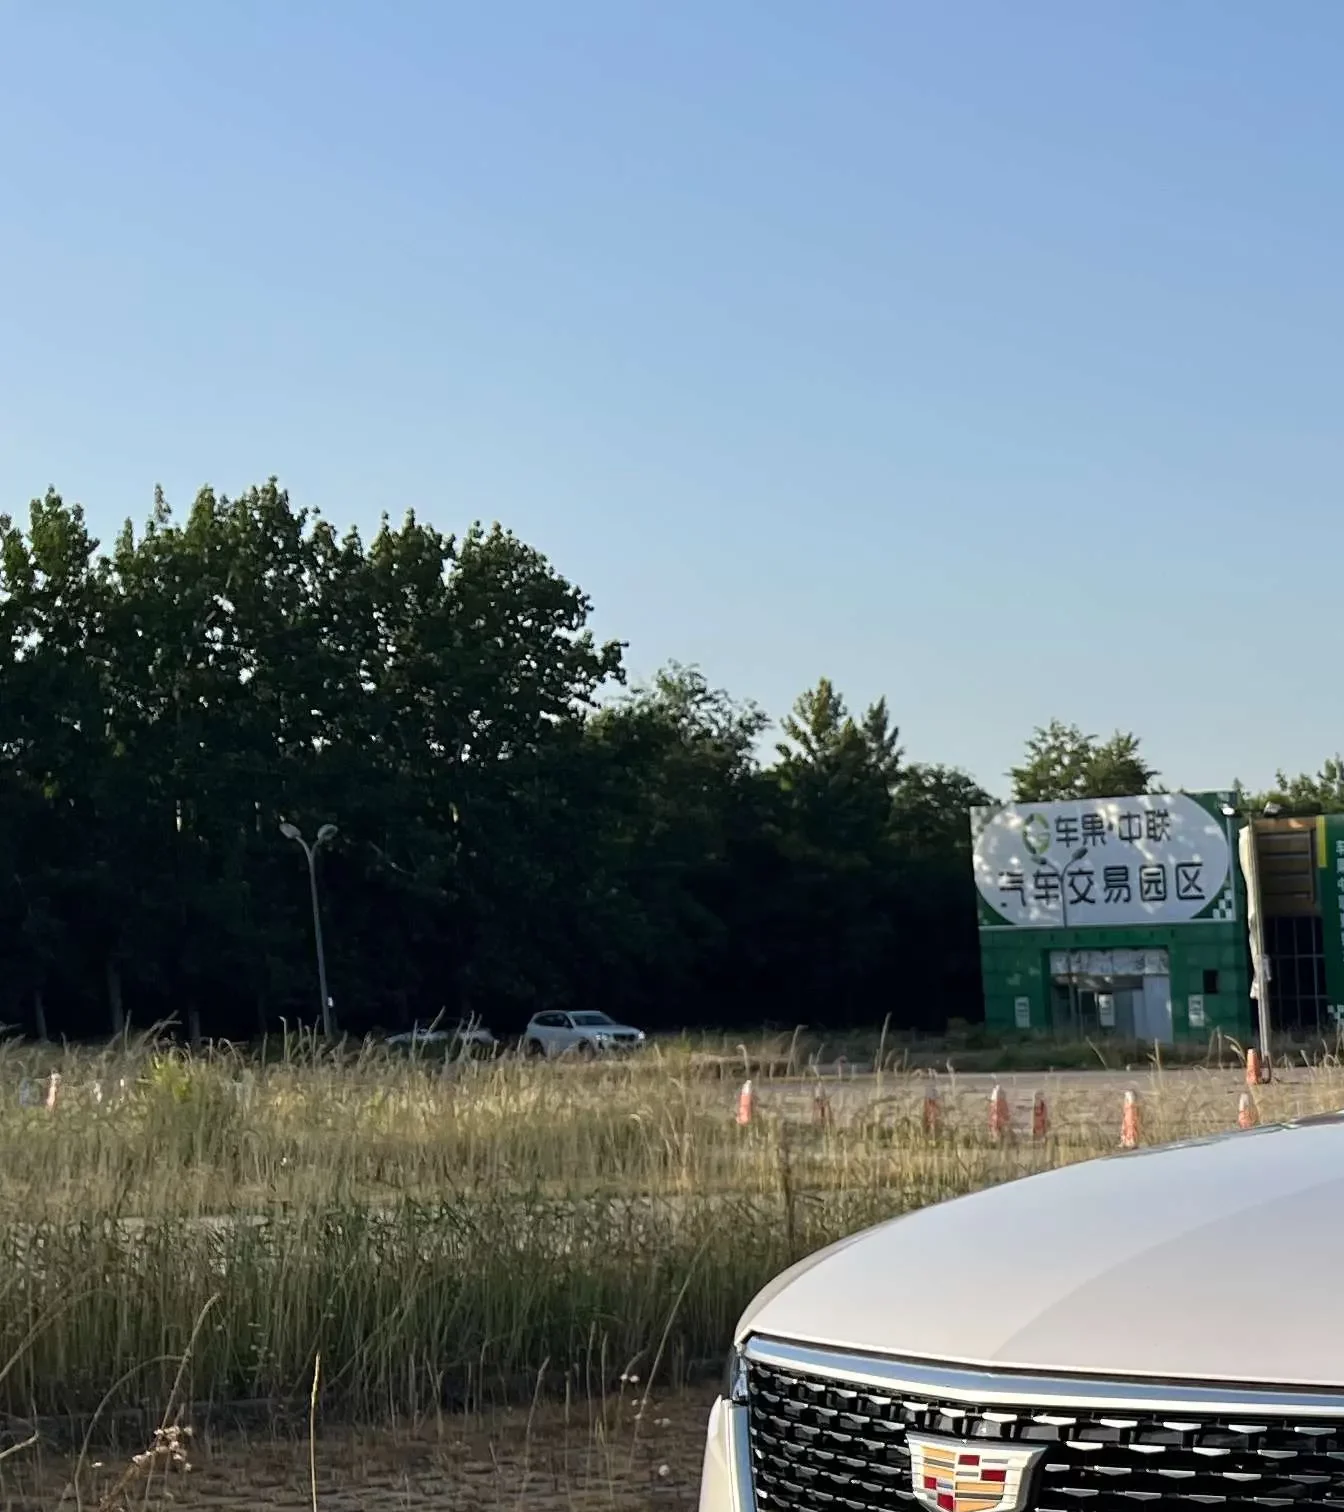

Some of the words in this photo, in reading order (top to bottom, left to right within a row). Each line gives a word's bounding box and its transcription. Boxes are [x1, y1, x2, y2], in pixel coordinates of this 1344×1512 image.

[1054, 809, 1172, 848] 车果·中联
[998, 861, 1206, 907] 汽车交易园区
